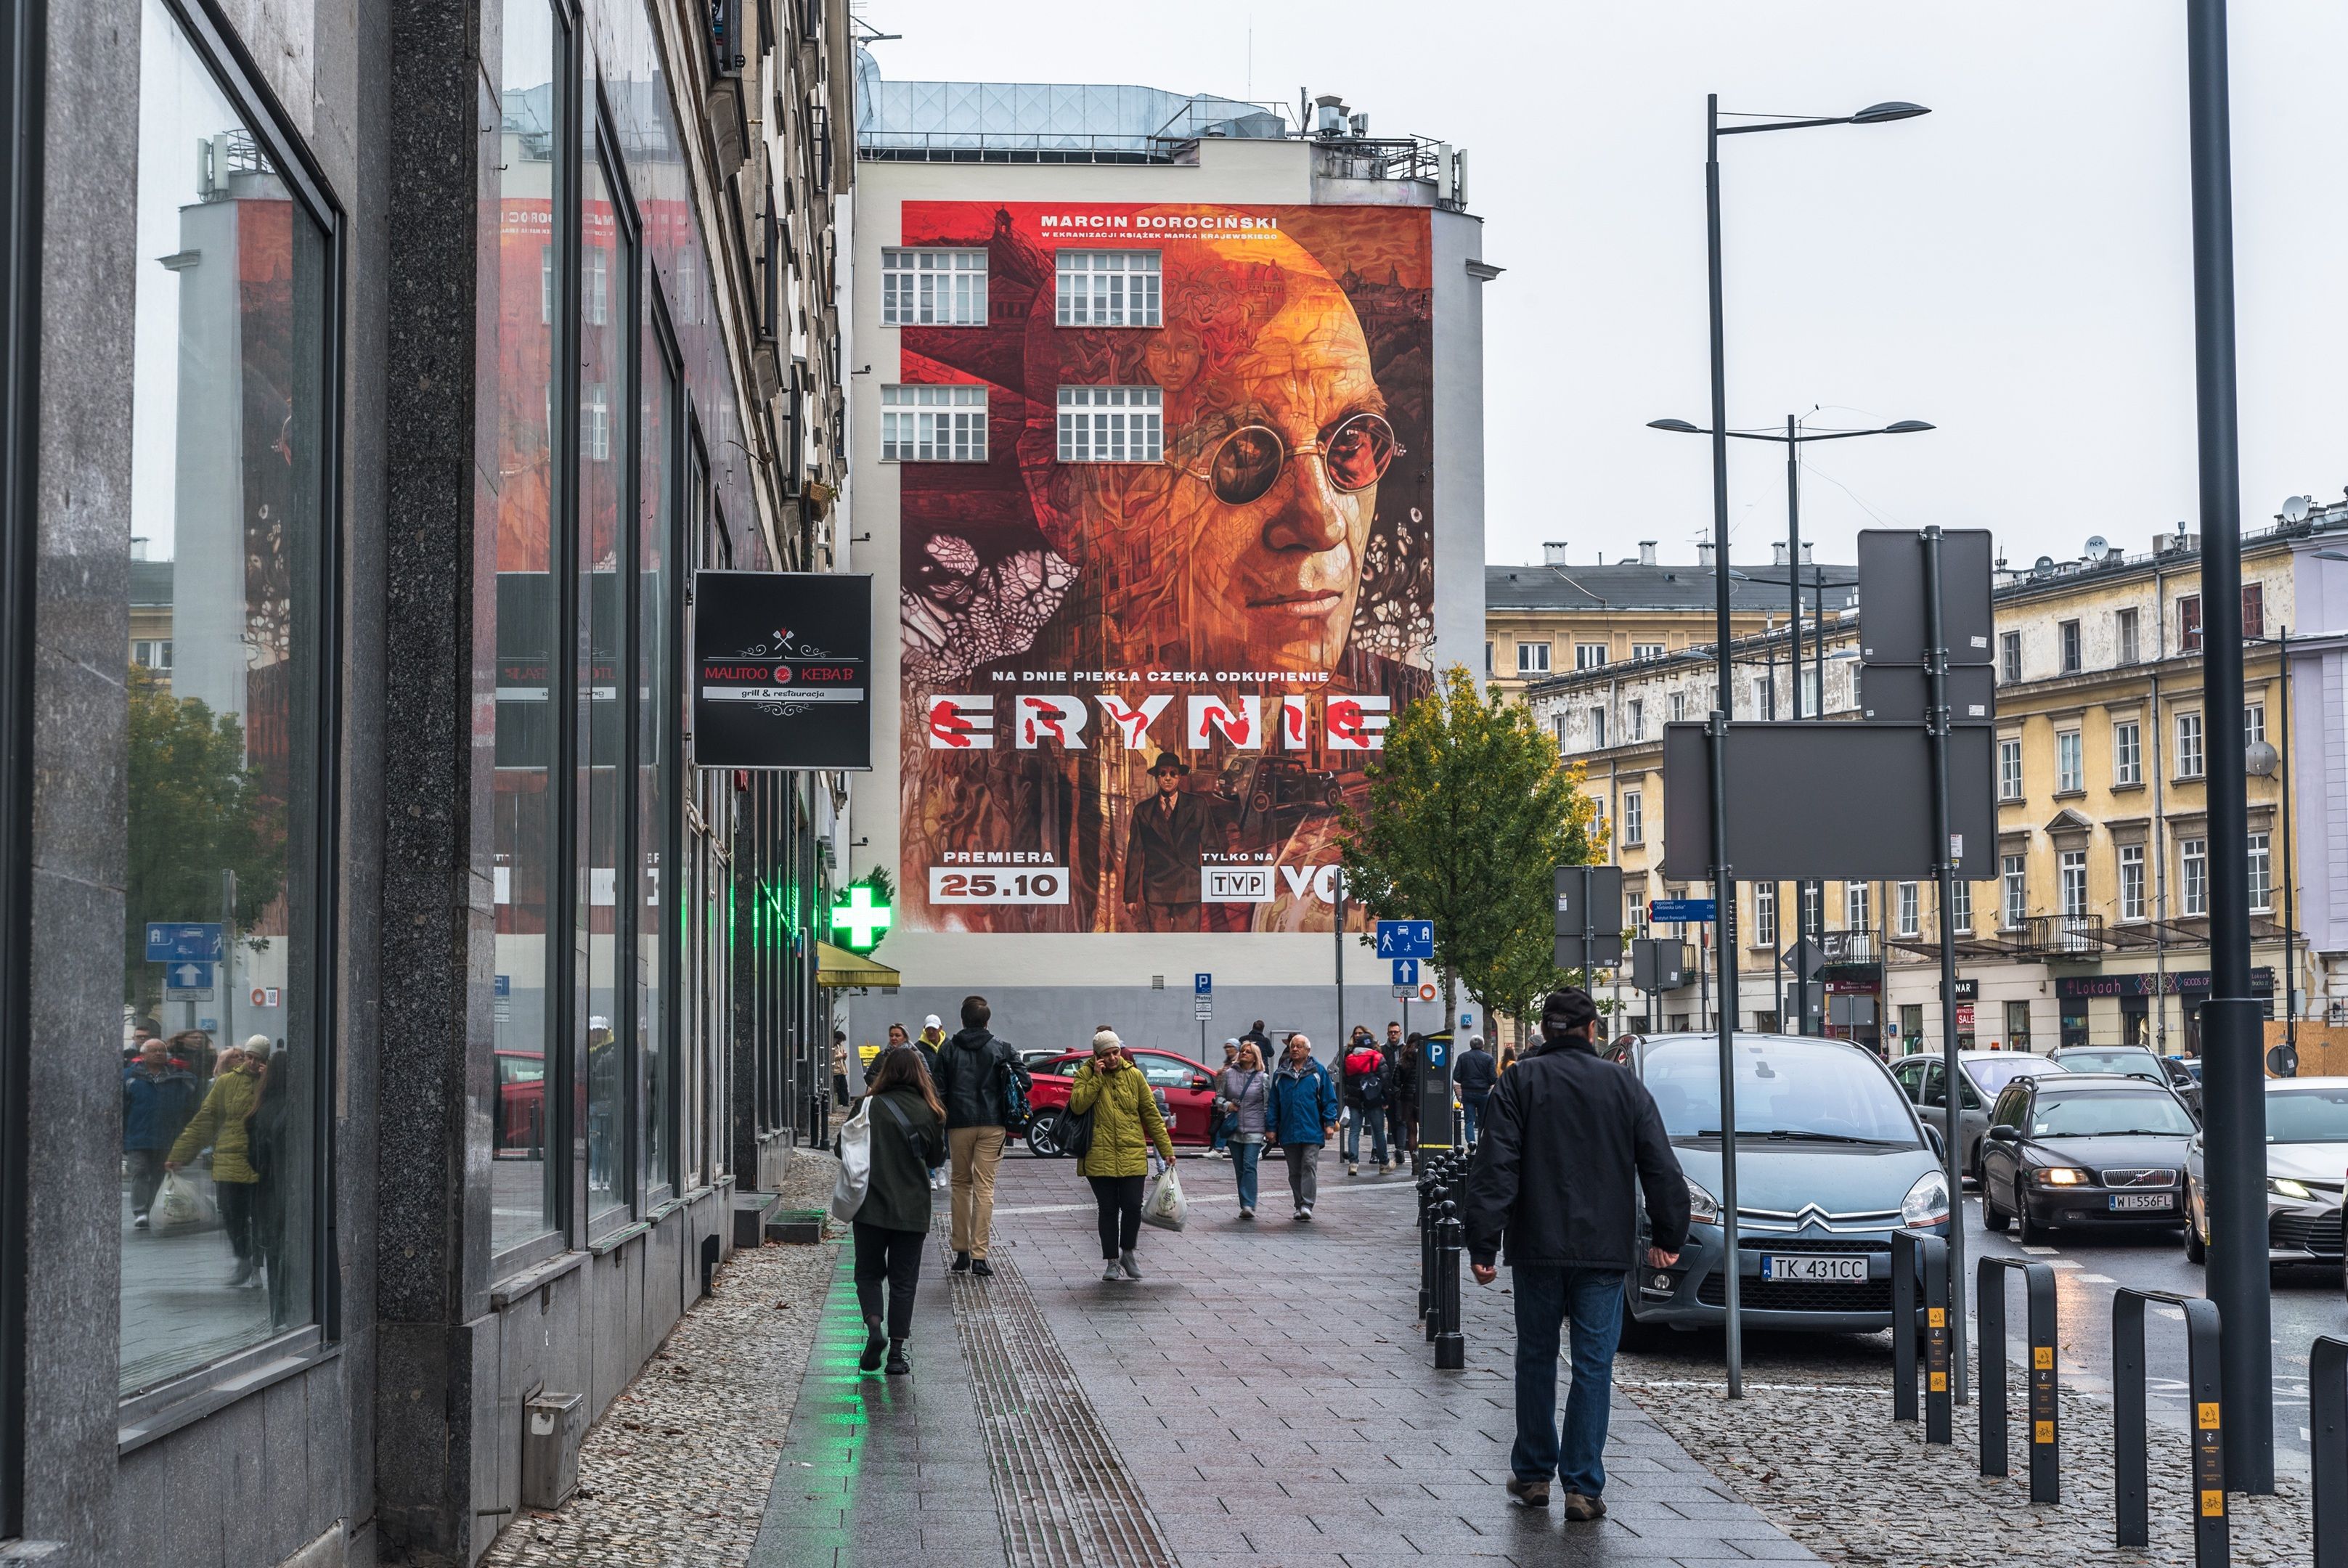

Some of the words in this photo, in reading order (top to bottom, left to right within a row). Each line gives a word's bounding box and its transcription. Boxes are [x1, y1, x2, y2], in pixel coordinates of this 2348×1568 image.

[1041, 216, 1128, 227] MARCIN
[1136, 214, 1277, 229] DOROCIŃSKI
[1120, 231, 1161, 240] KSIĄŻEK
[704, 667, 769, 680] MALITOO
[801, 668, 854, 680] KEBAB
[992, 671, 1016, 681] NA
[1022, 671, 1067, 682] DNIE
[1074, 671, 1141, 682] PIEKŁA
[1147, 671, 1209, 682] CZEKA
[1215, 671, 1329, 682] ODKUPIENIE
[741, 689, 759, 698] grill
[762, 689, 771, 698] &
[774, 690, 825, 698] restauracja
[929, 695, 1390, 750] ERYNIE
[944, 852, 1055, 863] PREMIERA
[939, 874, 1059, 897] 25.10
[1213, 875, 1262, 893] TVP
[1279, 865, 1371, 905] VO
[1199, 975, 1208, 988] P
[1955, 984, 1970, 992] NAR
[2076, 978, 2121, 995] Lokaah
[2183, 978, 2201, 987] GOODS
[2202, 977, 2210, 986] OF
[1958, 1015, 1975, 1024] SALE
[1432, 1045, 1443, 1063] P
[2137, 1196, 2171, 1206] 556FL
[1776, 1259, 1799, 1278] TK
[1806, 1260, 1863, 1278] 431CC
